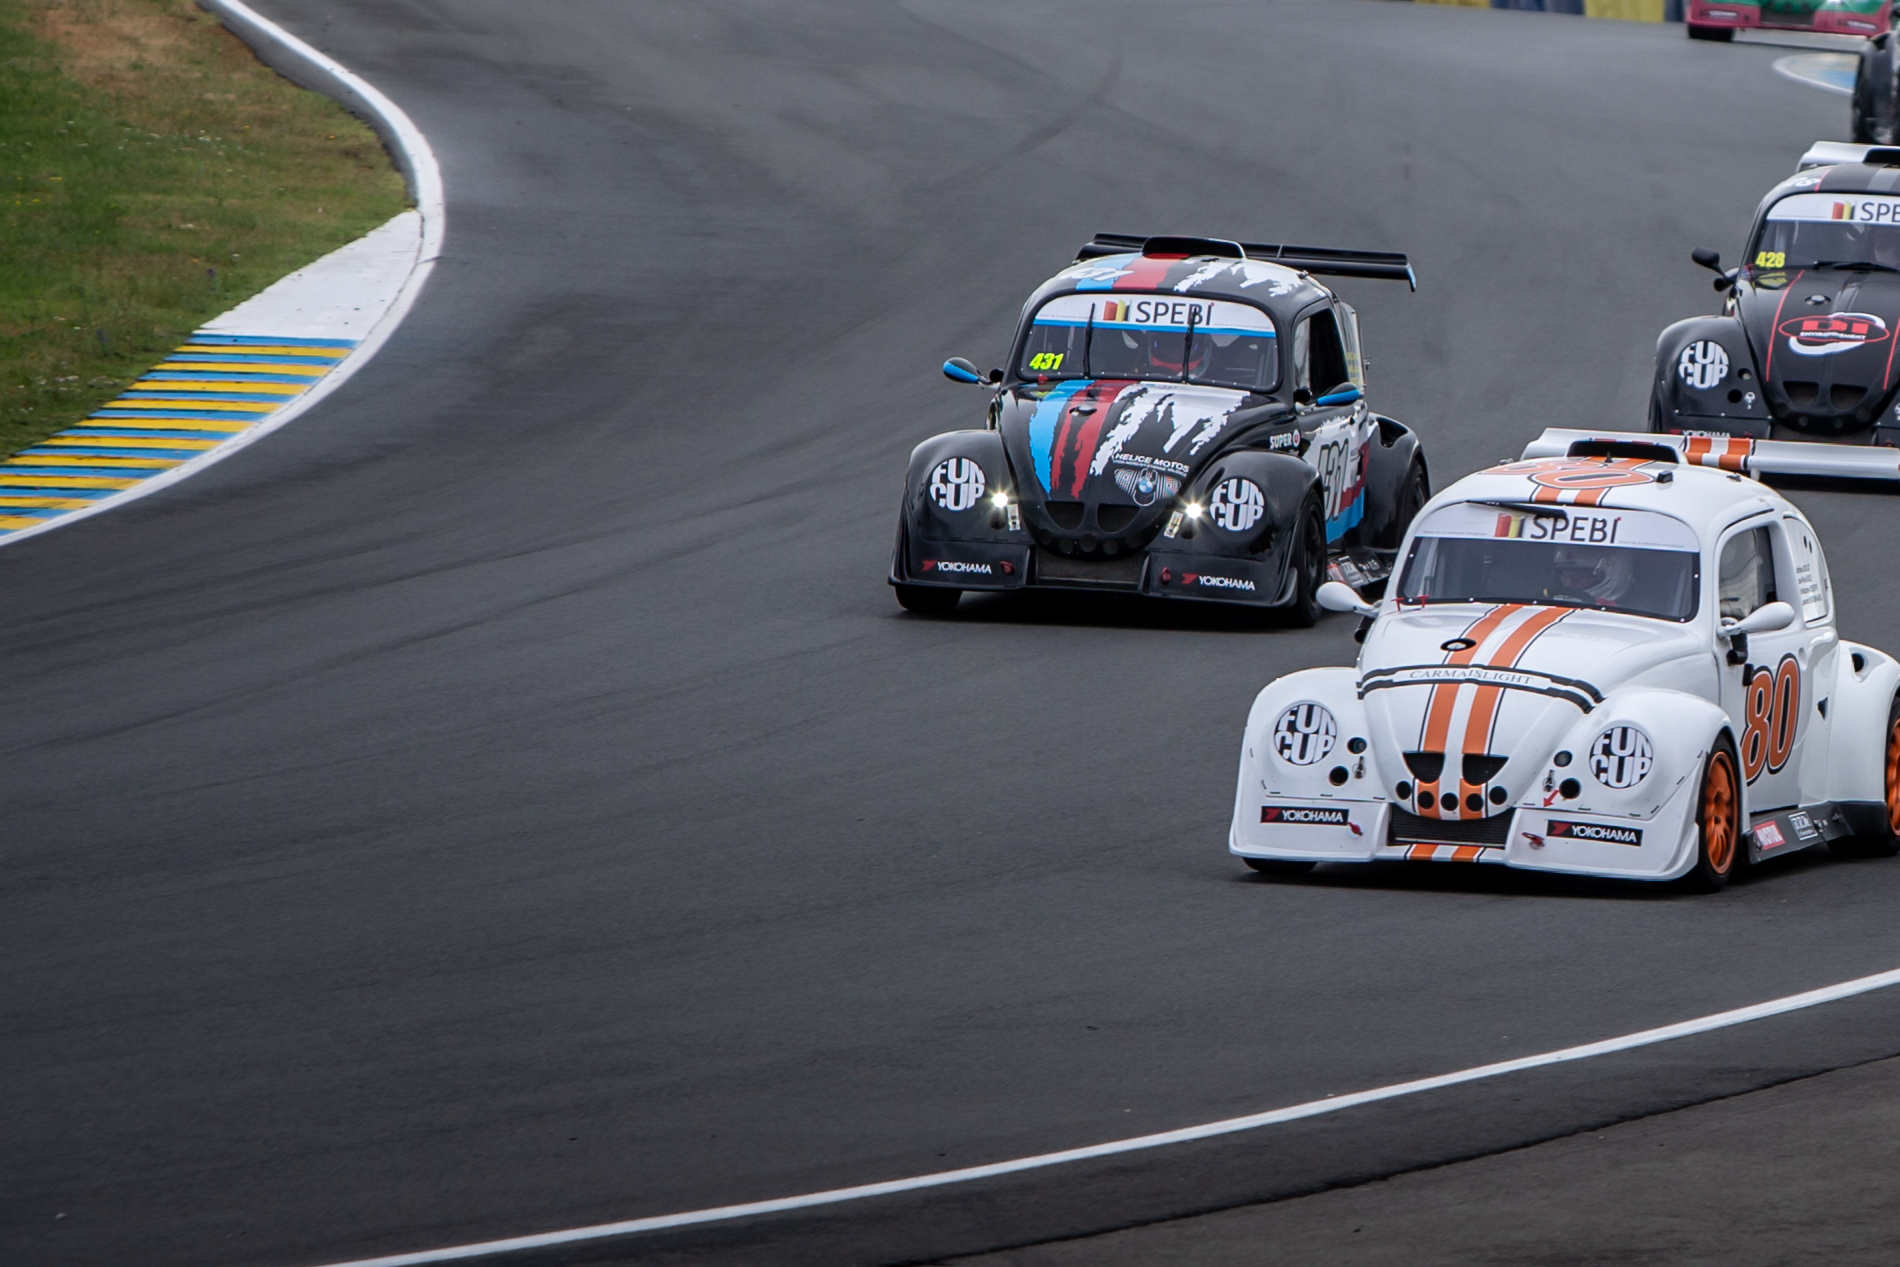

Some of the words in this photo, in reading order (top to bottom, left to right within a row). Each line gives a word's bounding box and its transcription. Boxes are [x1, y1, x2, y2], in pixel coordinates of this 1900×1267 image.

[1755, 251, 1786, 269] 428
[1135, 300, 1215, 326] SPEBI
[1029, 352, 1065, 371] 431
[1681, 340, 1729, 365] FUN
[1679, 362, 1728, 389] CUP
[932, 458, 985, 484] FUN
[1115, 453, 1153, 465] HELICE
[1154, 458, 1190, 473] MOTOS
[929, 482, 985, 511] CUP
[1212, 478, 1264, 506] FUN
[1210, 502, 1264, 531] CUP
[1530, 514, 1622, 544] SPEBI
[937, 561, 992, 574] YOKOHAMA
[1199, 575, 1256, 591] YOKOHAMA
[1277, 703, 1336, 736] FUN
[1740, 652, 1801, 788] 80
[1274, 731, 1335, 765] CUP
[1592, 726, 1653, 758] FUN
[1590, 754, 1653, 789] CUP
[1282, 809, 1344, 823] YOKOHAMA
[1571, 825, 1638, 843] YOKOHAMA
